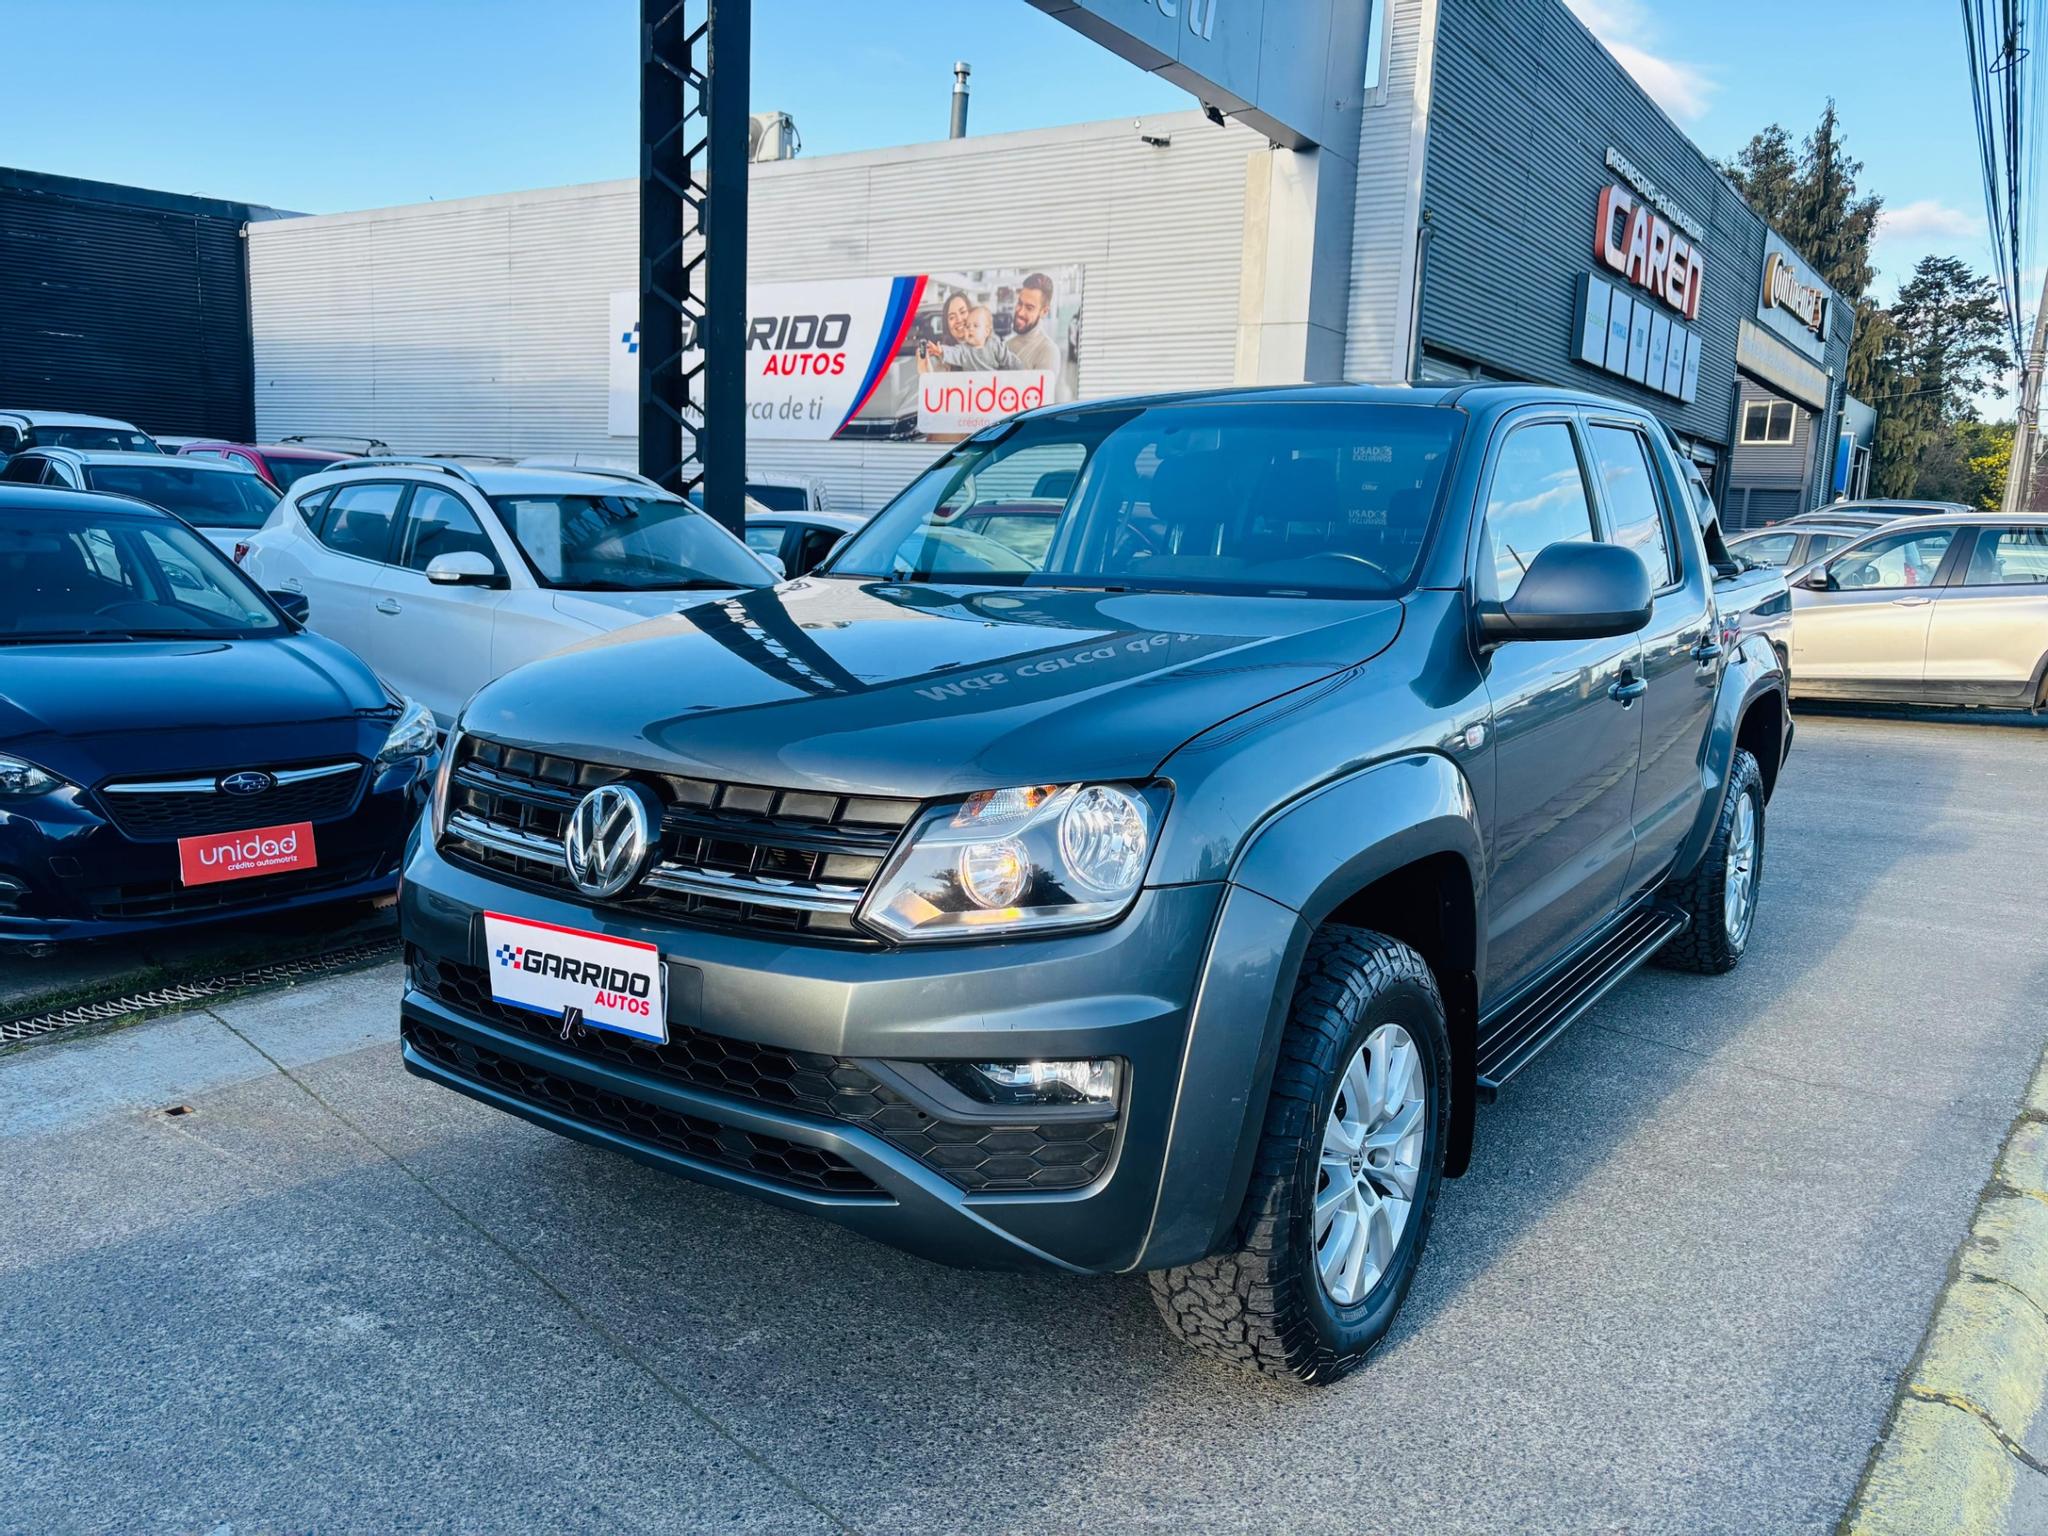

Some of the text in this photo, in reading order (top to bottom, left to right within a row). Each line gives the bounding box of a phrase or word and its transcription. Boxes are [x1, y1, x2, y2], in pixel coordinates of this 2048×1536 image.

[1602, 184, 1703, 320] CAREN
[763, 353, 846, 376] AUTOS
[779, 395, 803, 420] de
[809, 396, 823, 420] ti
[925, 374, 1044, 413] unidad
[200, 830, 297, 865] unidad
[227, 855, 298, 871] crédito automotriz
[523, 949, 651, 998] GARRIDO
[594, 990, 650, 1016] AUTOS
